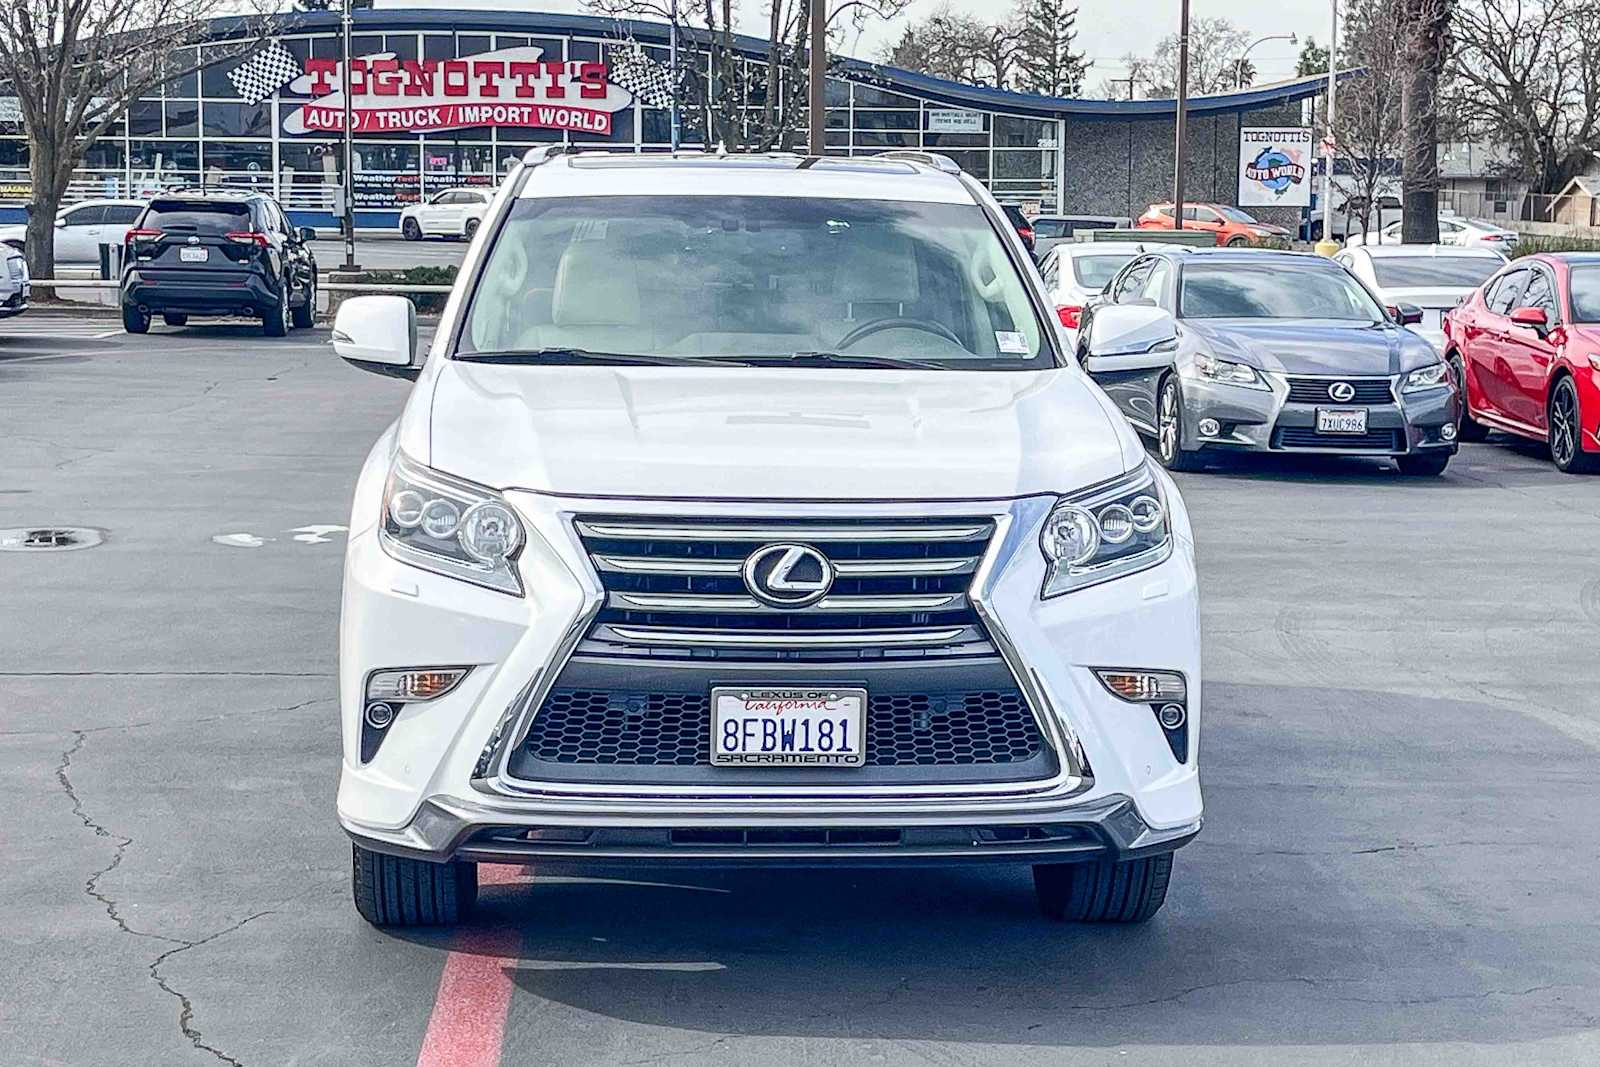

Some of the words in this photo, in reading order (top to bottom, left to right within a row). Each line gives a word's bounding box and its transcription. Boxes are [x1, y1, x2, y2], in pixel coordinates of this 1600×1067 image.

[304, 58, 607, 99] TOGNOTTI'S
[307, 109, 360, 129] AUTO
[376, 108, 442, 128] TRUCK
[458, 106, 533, 125] IMPORT
[538, 107, 608, 132] WORLD
[750, 691, 803, 699] LEXUS
[723, 718, 853, 752] 8FBW181
[716, 754, 860, 764] SACRAMENTO
